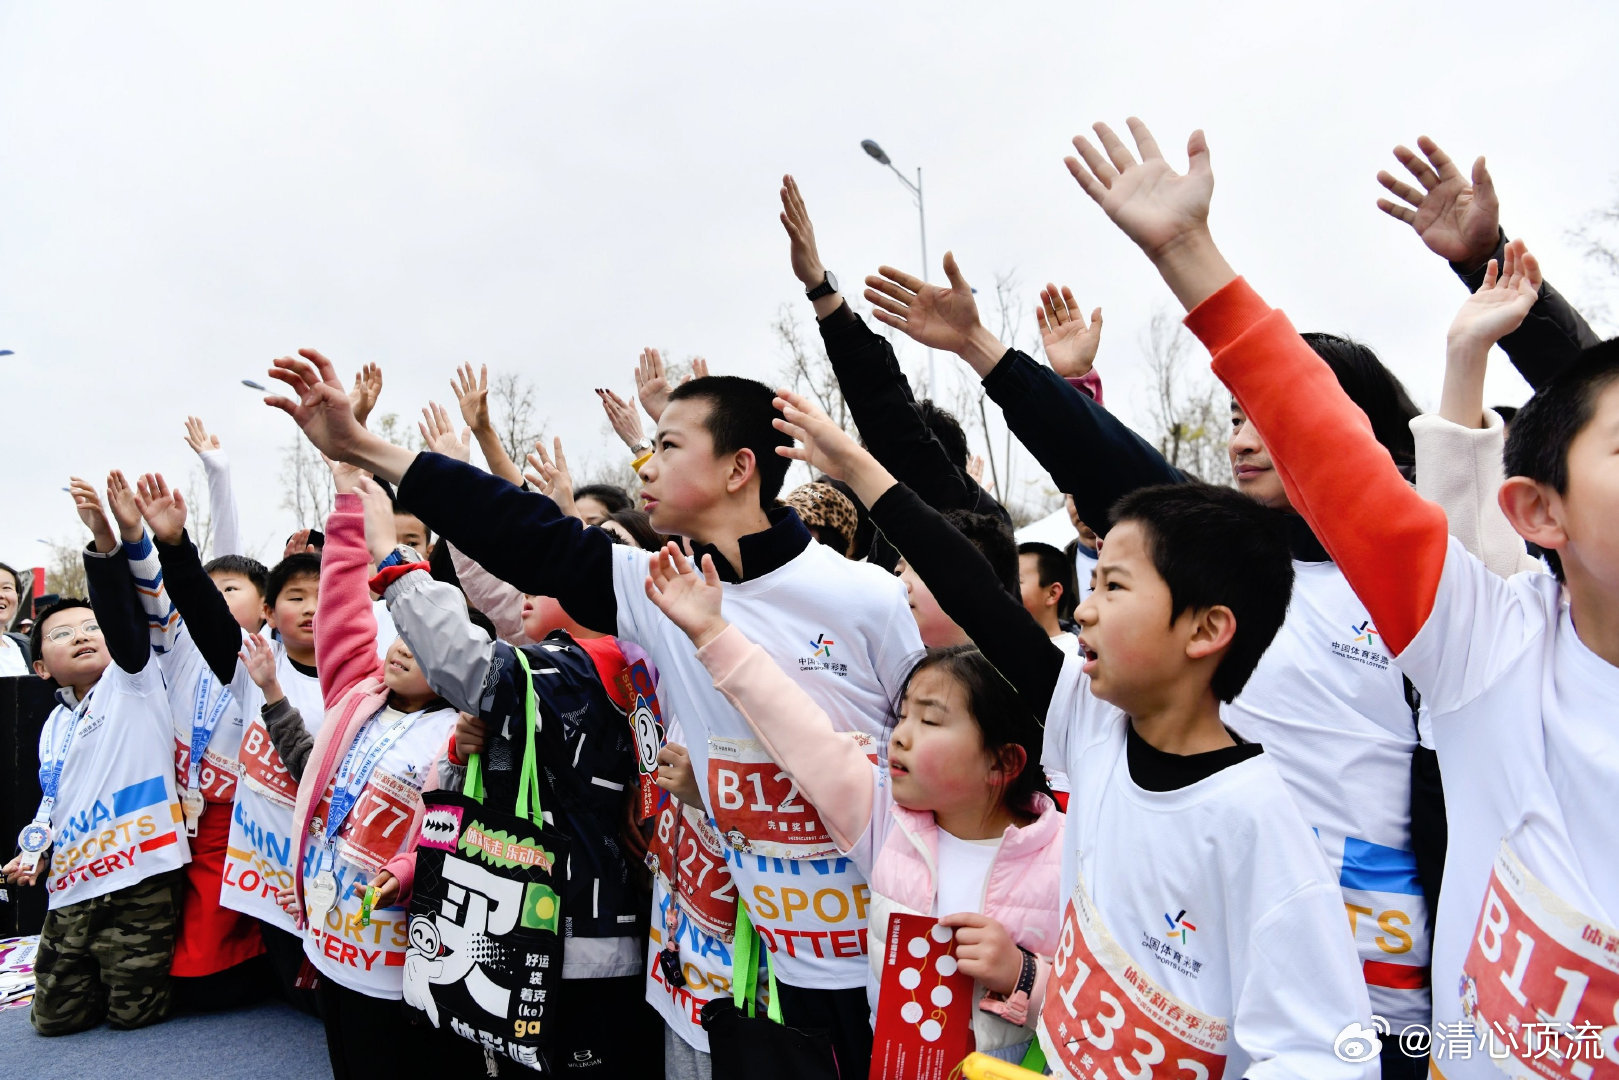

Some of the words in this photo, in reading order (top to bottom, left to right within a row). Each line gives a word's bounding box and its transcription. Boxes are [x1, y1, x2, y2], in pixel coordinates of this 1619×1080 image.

[1332, 641, 1390, 665] 中国体育彩票
[798, 657, 848, 672] 中国育彩票
[1346, 655, 1366, 664] SPORTS
[1366, 661, 1388, 670] LOTTERY
[718, 769, 805, 813] B12
[234, 800, 293, 868] CHIN
[54, 815, 157, 874] SPORTS
[658, 809, 736, 903] B1272
[525, 952, 550, 968] 好运
[529, 971, 543, 985] 袋
[520, 988, 547, 1002] 着克
[518, 1003, 544, 1017] (ke)
[514, 1020, 541, 1038] ga
